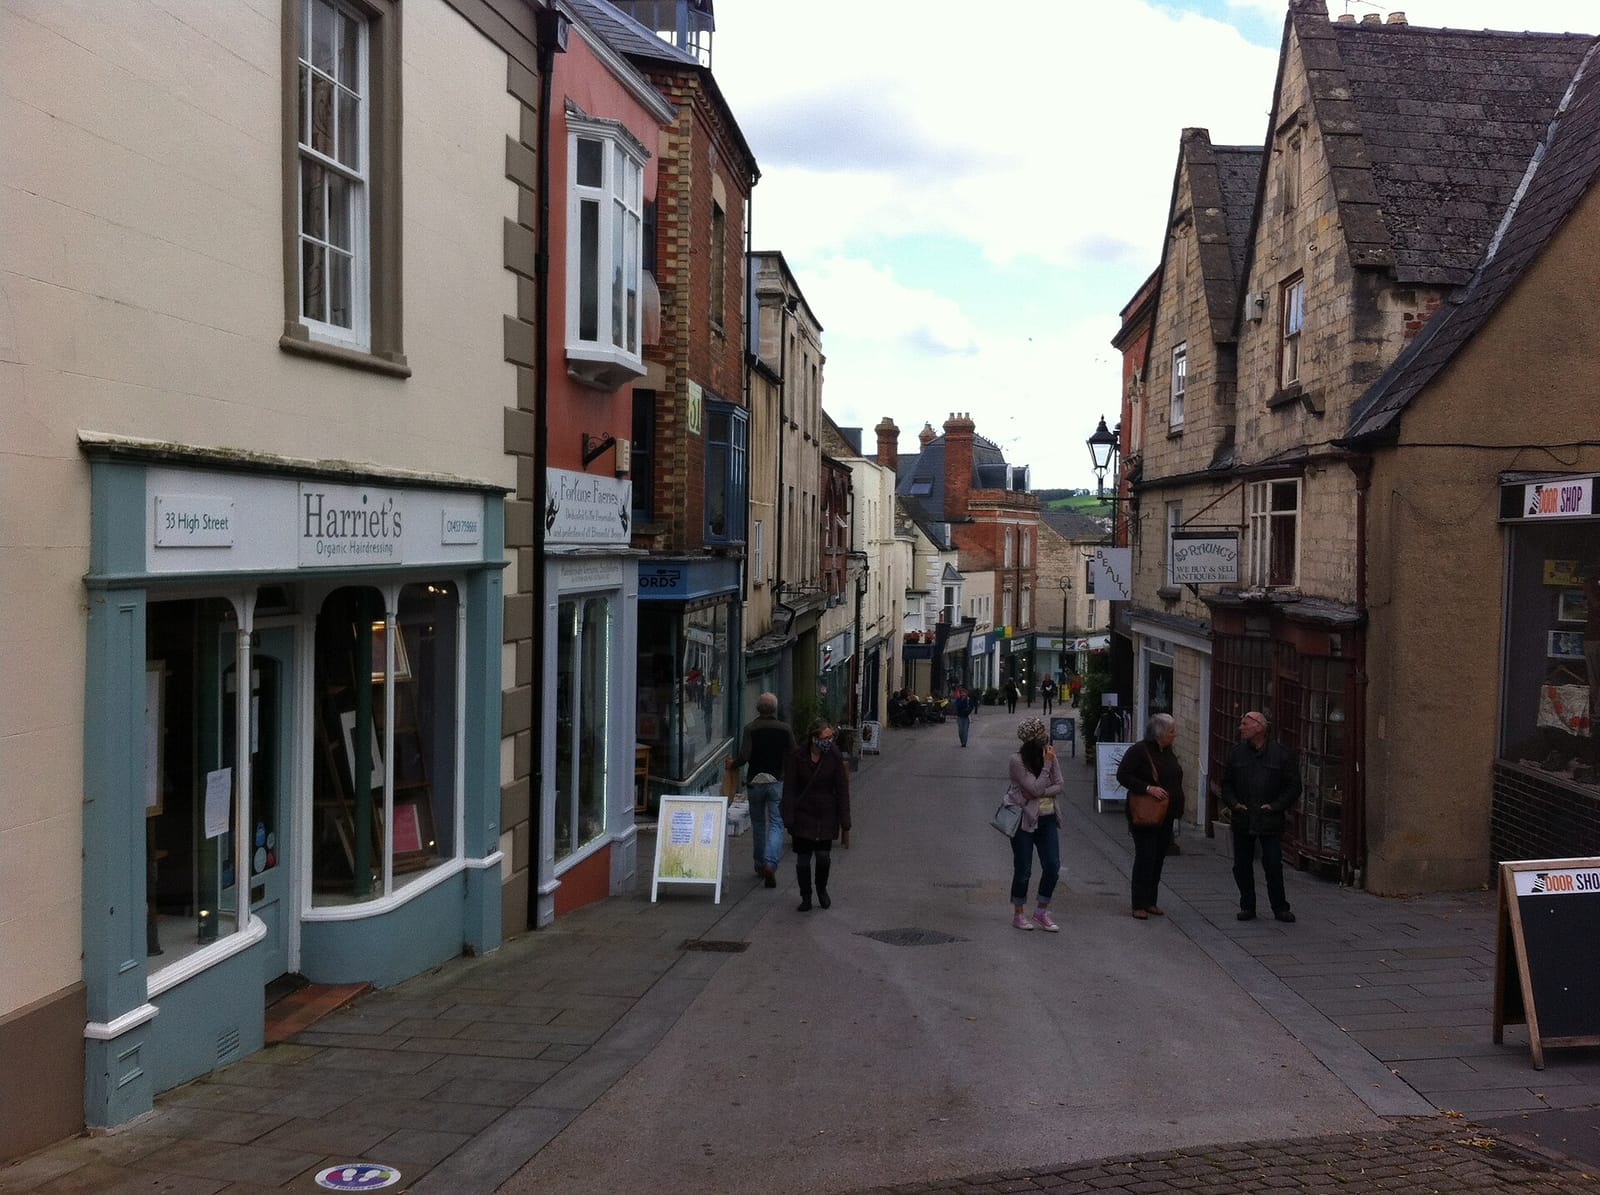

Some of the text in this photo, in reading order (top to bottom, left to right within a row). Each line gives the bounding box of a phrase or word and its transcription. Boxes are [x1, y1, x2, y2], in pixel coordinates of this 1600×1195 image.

[560, 475, 592, 502] Fortune
[1539, 486, 1583, 514] DOOR SHOP
[165, 512, 229, 534] 33 High Street
[303, 493, 402, 538] Harriet's
[316, 539, 393, 557] Organic Hairdressing
[1096, 550, 1129, 599] BEAUTY
[1176, 565, 1190, 573] WE
[1191, 565, 1207, 573] BUY
[1217, 565, 1235, 573] SELL
[1176, 573, 1217, 581] ANTIQUES
[1545, 873, 1600, 892] DOOR SHO
